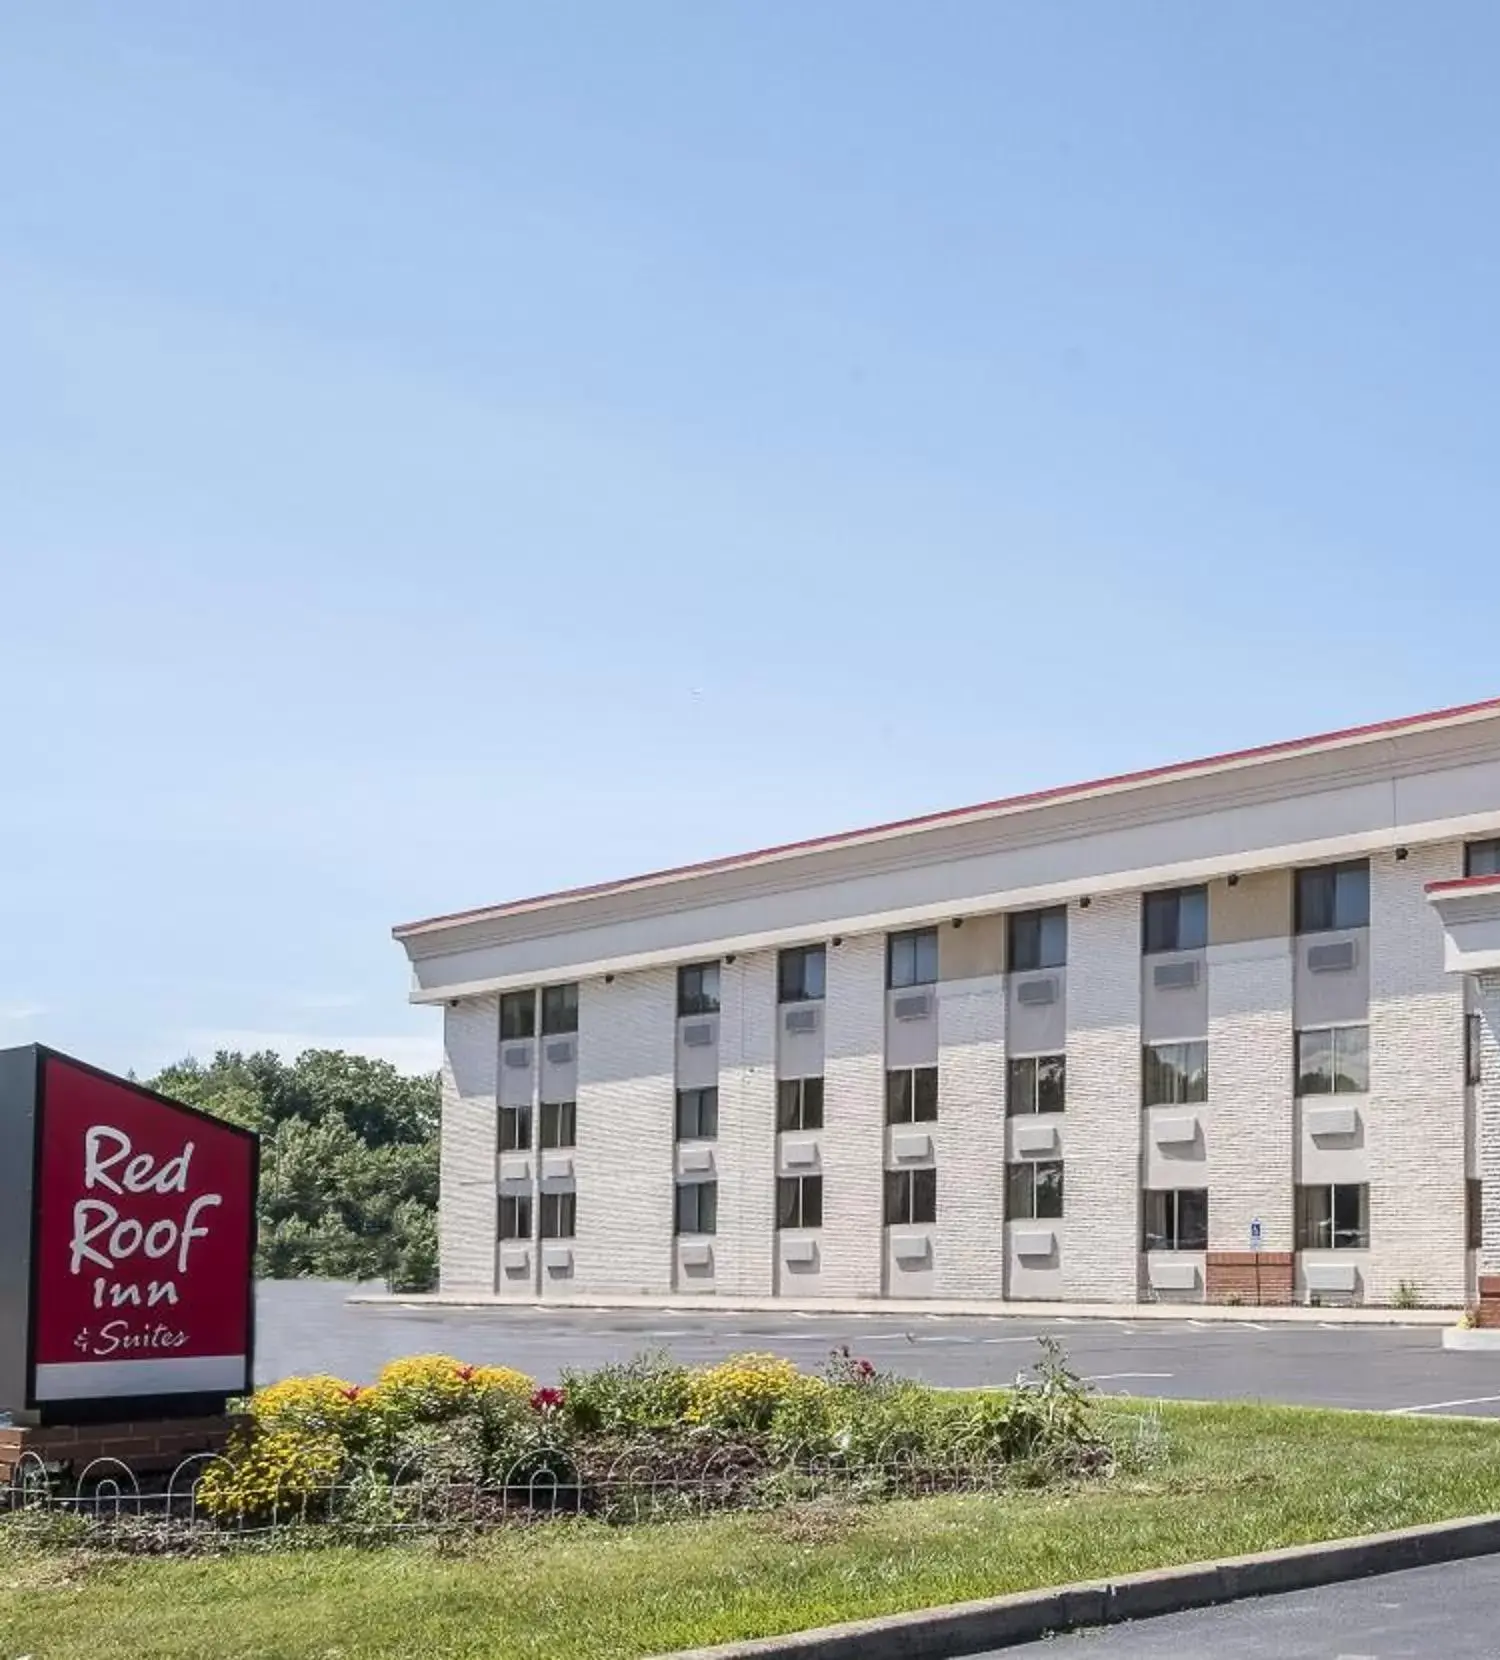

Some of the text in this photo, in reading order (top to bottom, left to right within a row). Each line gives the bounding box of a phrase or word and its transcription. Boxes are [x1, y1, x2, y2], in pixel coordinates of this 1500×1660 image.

[85, 1125, 195, 1195] Red
[69, 1194, 223, 1275] Roof
[93, 1277, 180, 1308] Inn
[93, 1320, 191, 1355] Suites
